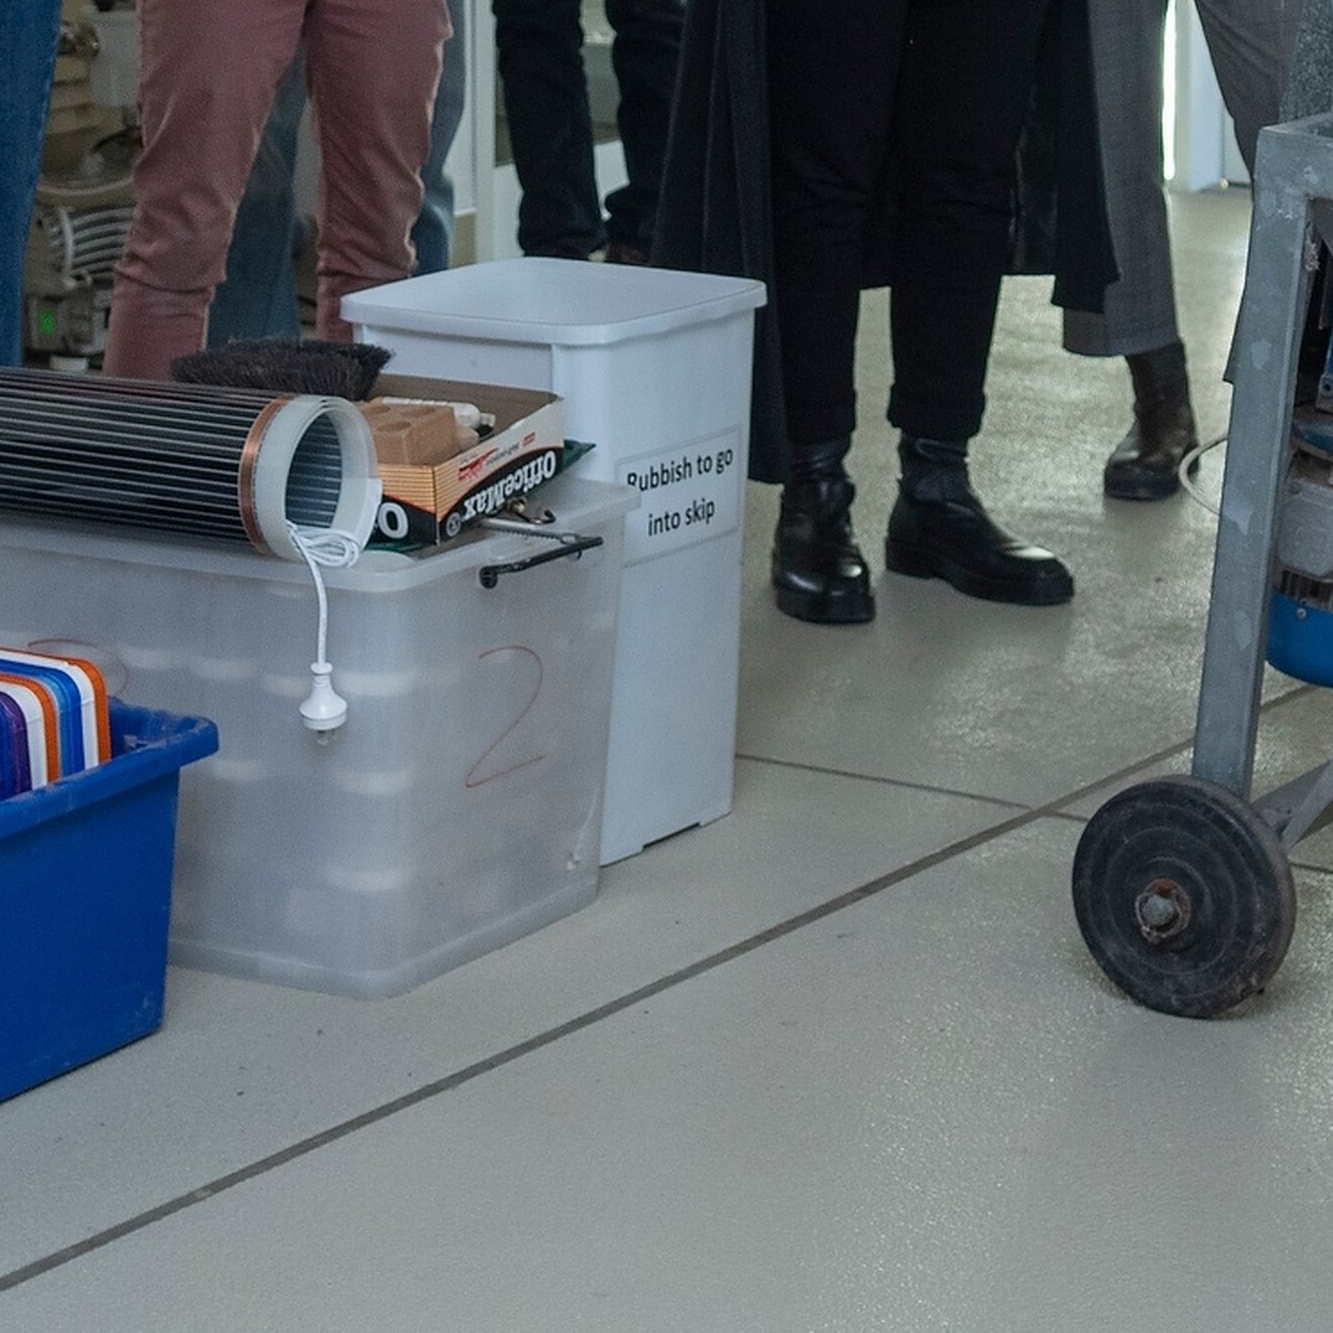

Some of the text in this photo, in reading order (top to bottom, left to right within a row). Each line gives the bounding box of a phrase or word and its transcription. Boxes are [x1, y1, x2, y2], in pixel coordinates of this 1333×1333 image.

[464, 450, 557, 521] OfficeMax
[697, 455, 713, 475] to
[716, 448, 734, 474] go
[648, 498, 715, 536] into skip
[464, 644, 546, 789] 2
